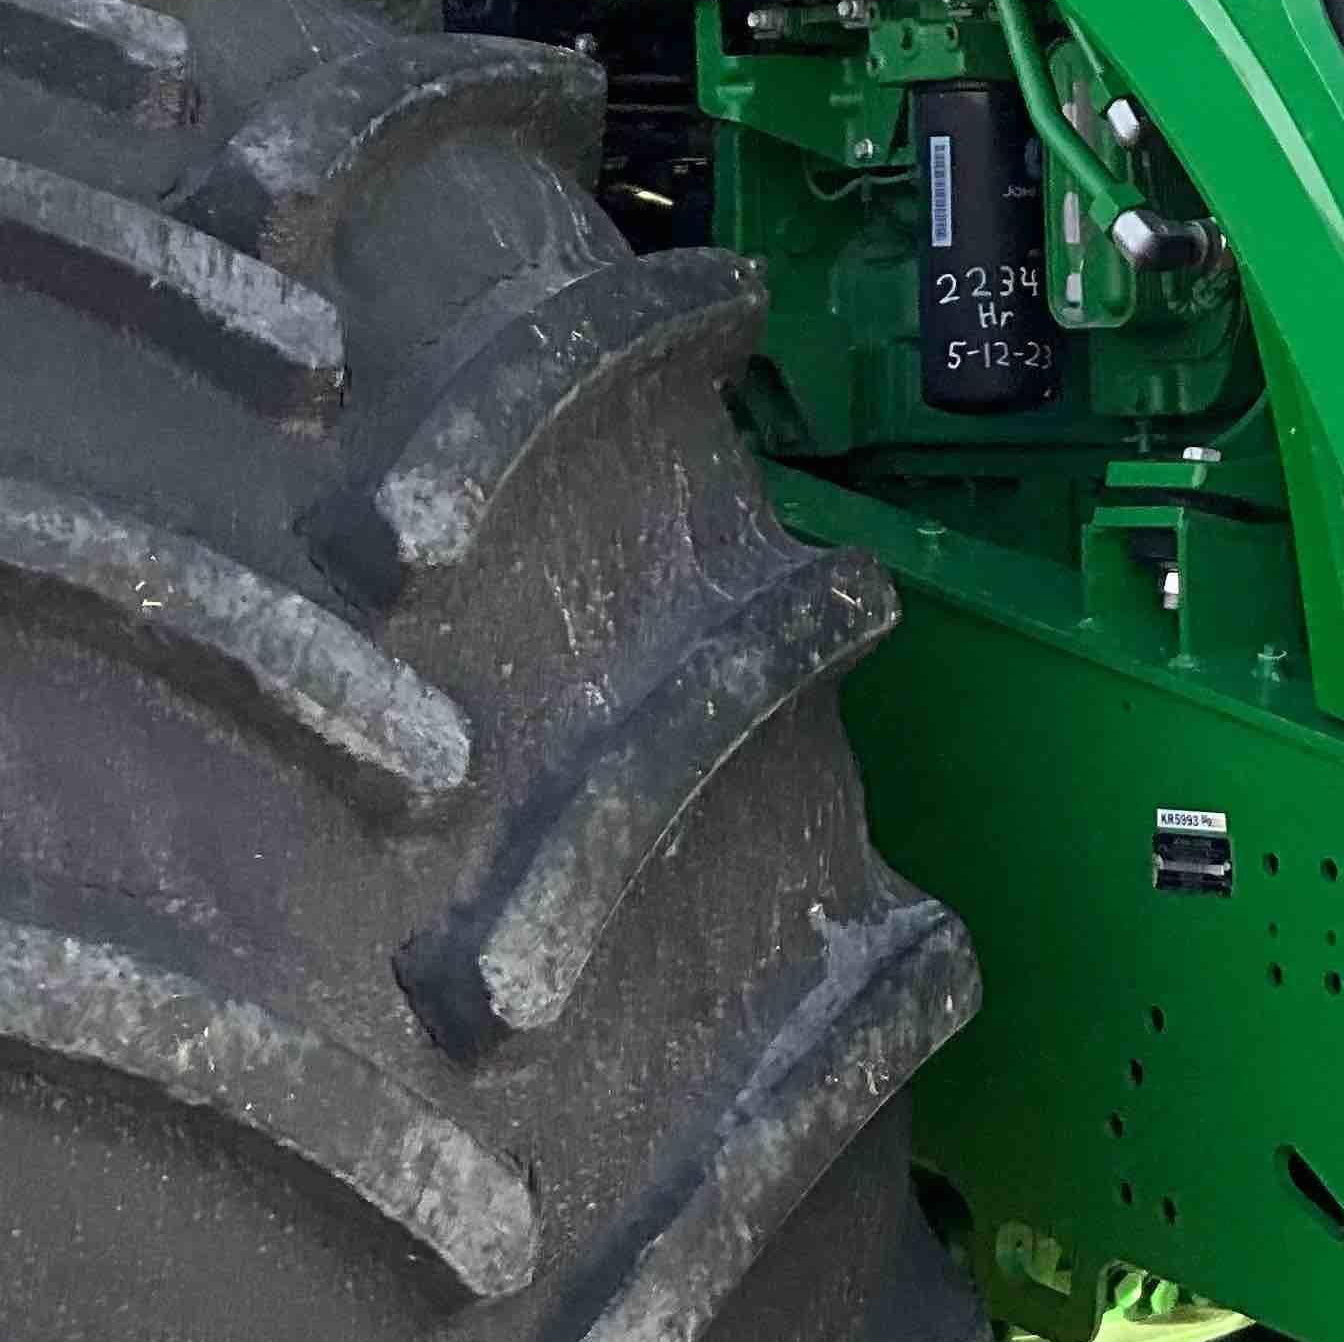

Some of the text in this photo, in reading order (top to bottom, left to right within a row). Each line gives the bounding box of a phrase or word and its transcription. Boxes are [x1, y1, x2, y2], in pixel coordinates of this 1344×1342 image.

[936, 266, 1041, 305] 2234
[977, 301, 1014, 329] Hr
[946, 341, 1053, 370] 5-12-23
